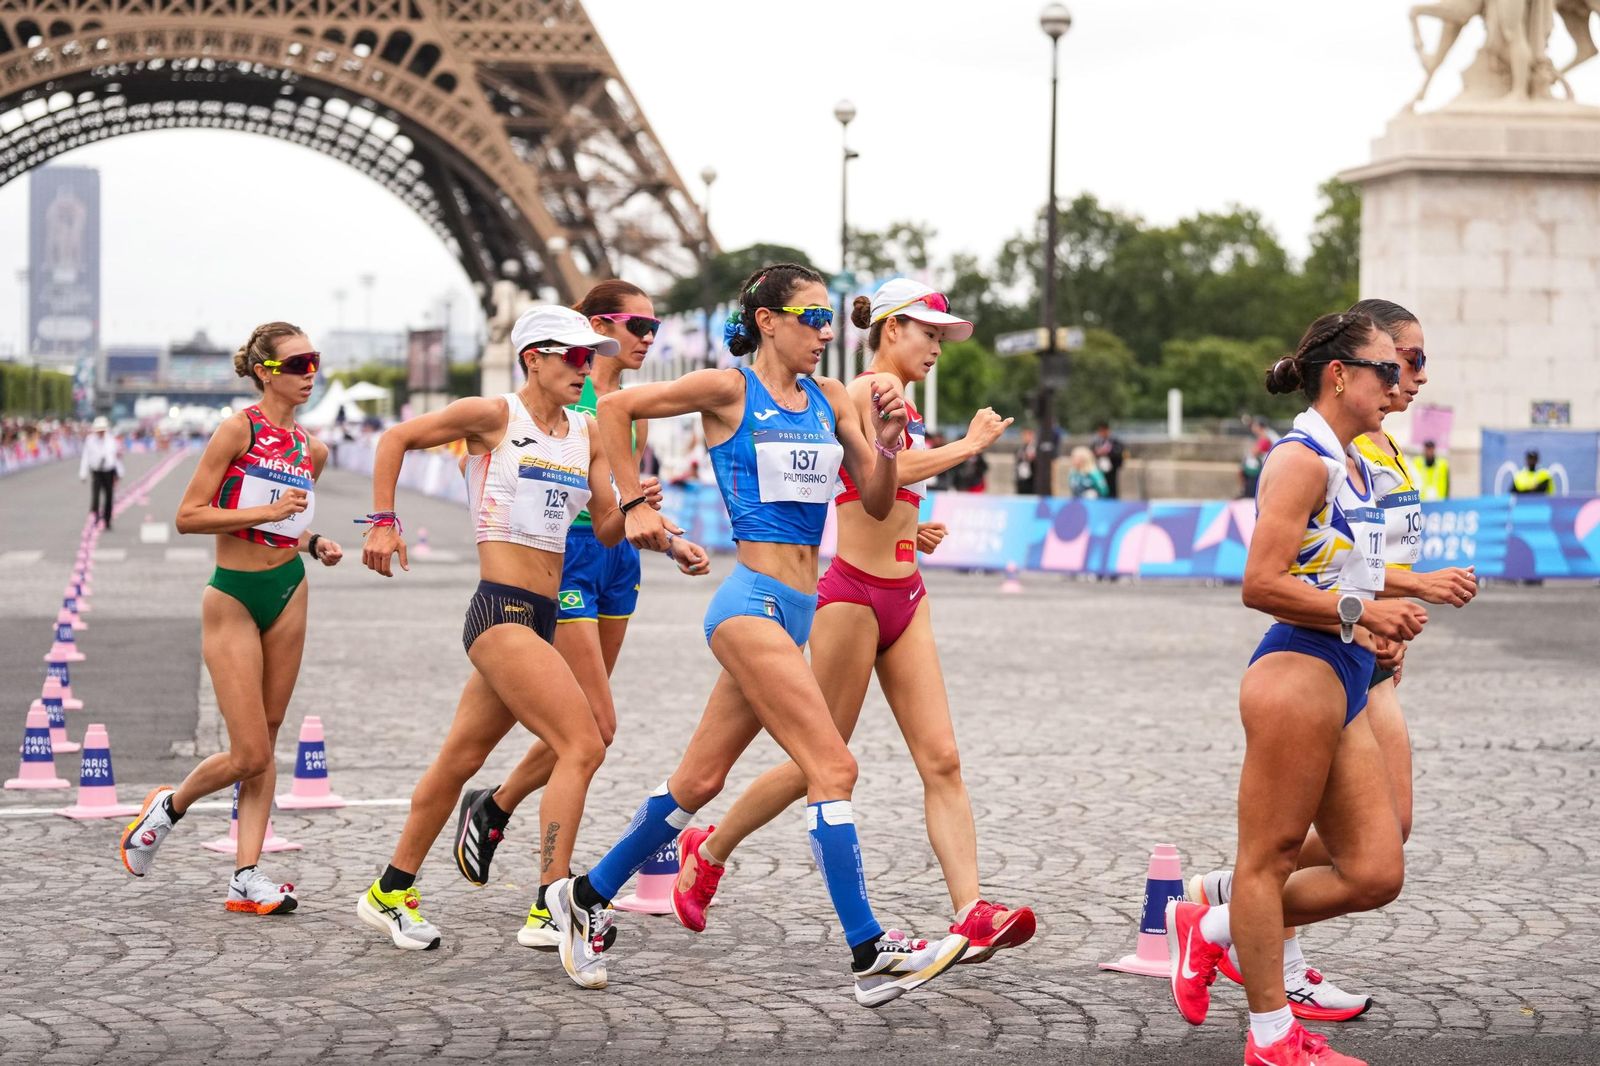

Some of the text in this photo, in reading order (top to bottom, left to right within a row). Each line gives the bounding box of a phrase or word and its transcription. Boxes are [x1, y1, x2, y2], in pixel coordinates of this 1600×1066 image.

[778, 432, 802, 440] PARIS
[790, 449, 819, 471] 137
[268, 471, 305, 486] PARIS 2024
[542, 471, 581, 484] PARIS 2024
[783, 472, 828, 484] PALMISANO
[544, 488, 569, 508] 123
[1398, 494, 1418, 503] PARIS
[543, 509, 565, 520] PEREZ
[1405, 511, 1422, 533] 10
[1368, 531, 1383, 555] 111
[1422, 536, 1477, 561] 024
[25, 736, 51, 745] PARIS
[80, 768, 109, 778] 2024
